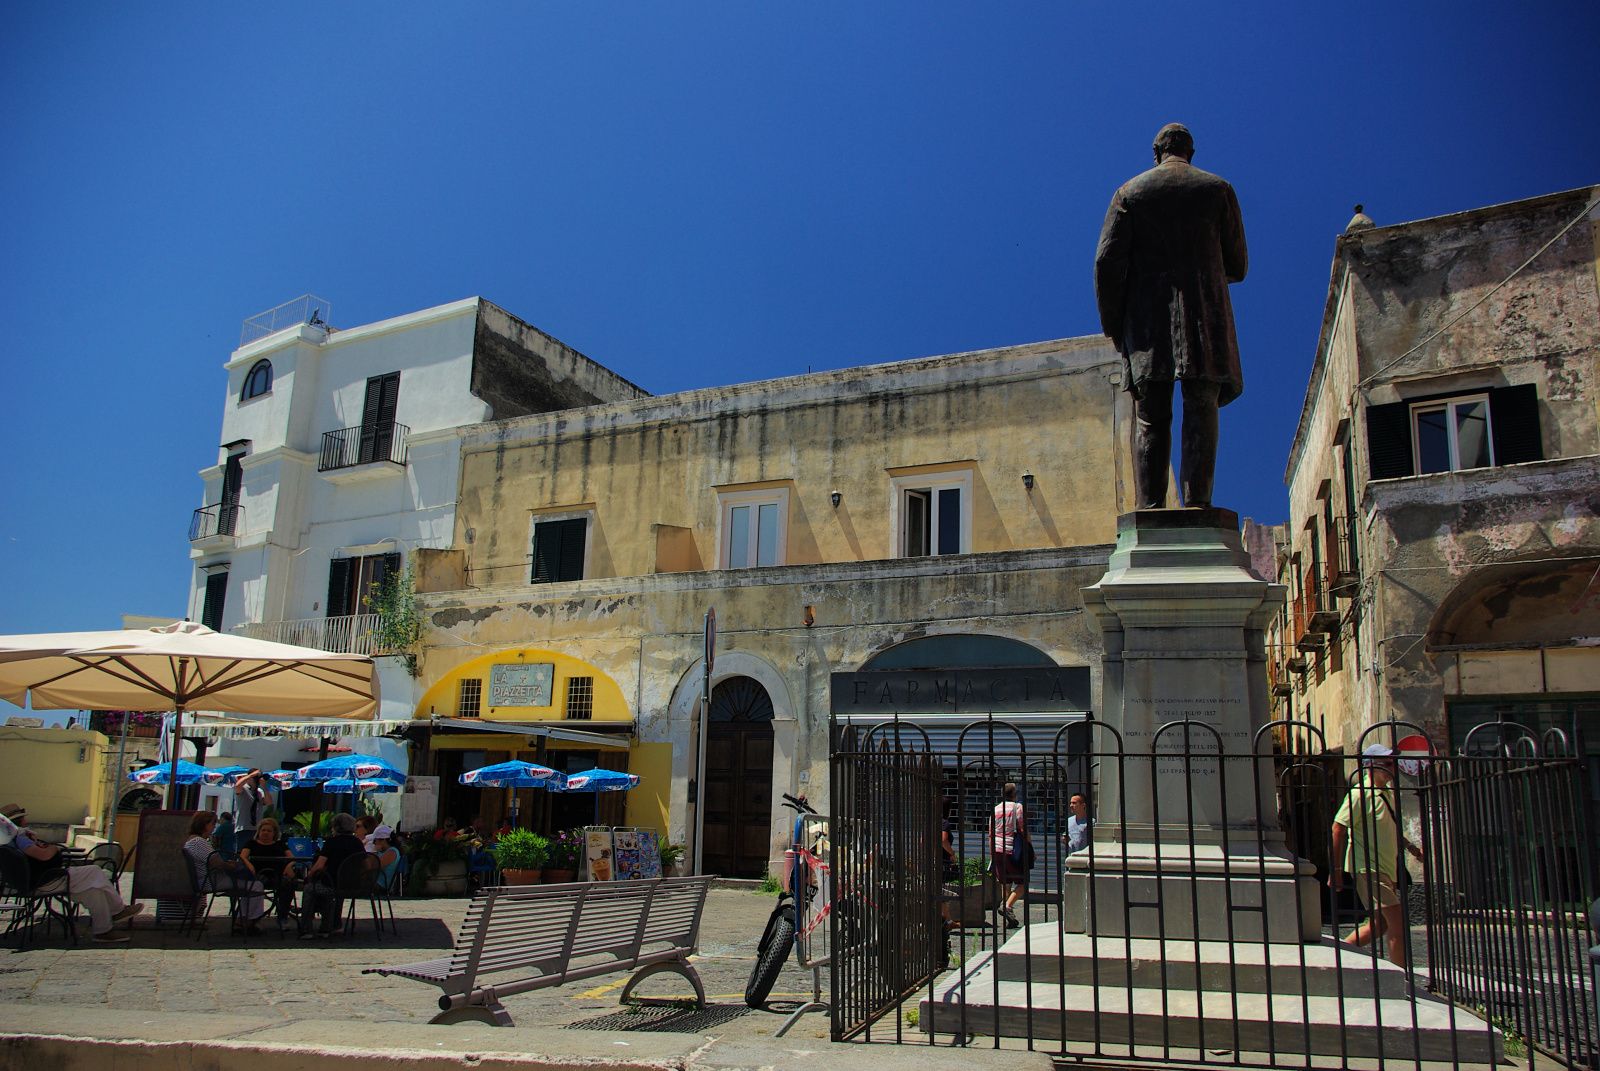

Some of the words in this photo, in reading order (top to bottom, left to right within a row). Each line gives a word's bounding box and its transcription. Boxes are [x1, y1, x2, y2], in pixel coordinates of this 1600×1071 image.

[494, 673, 507, 684] LA
[493, 685, 543, 698] PIAZZETTA
[852, 677, 1065, 705] FARMACIA
